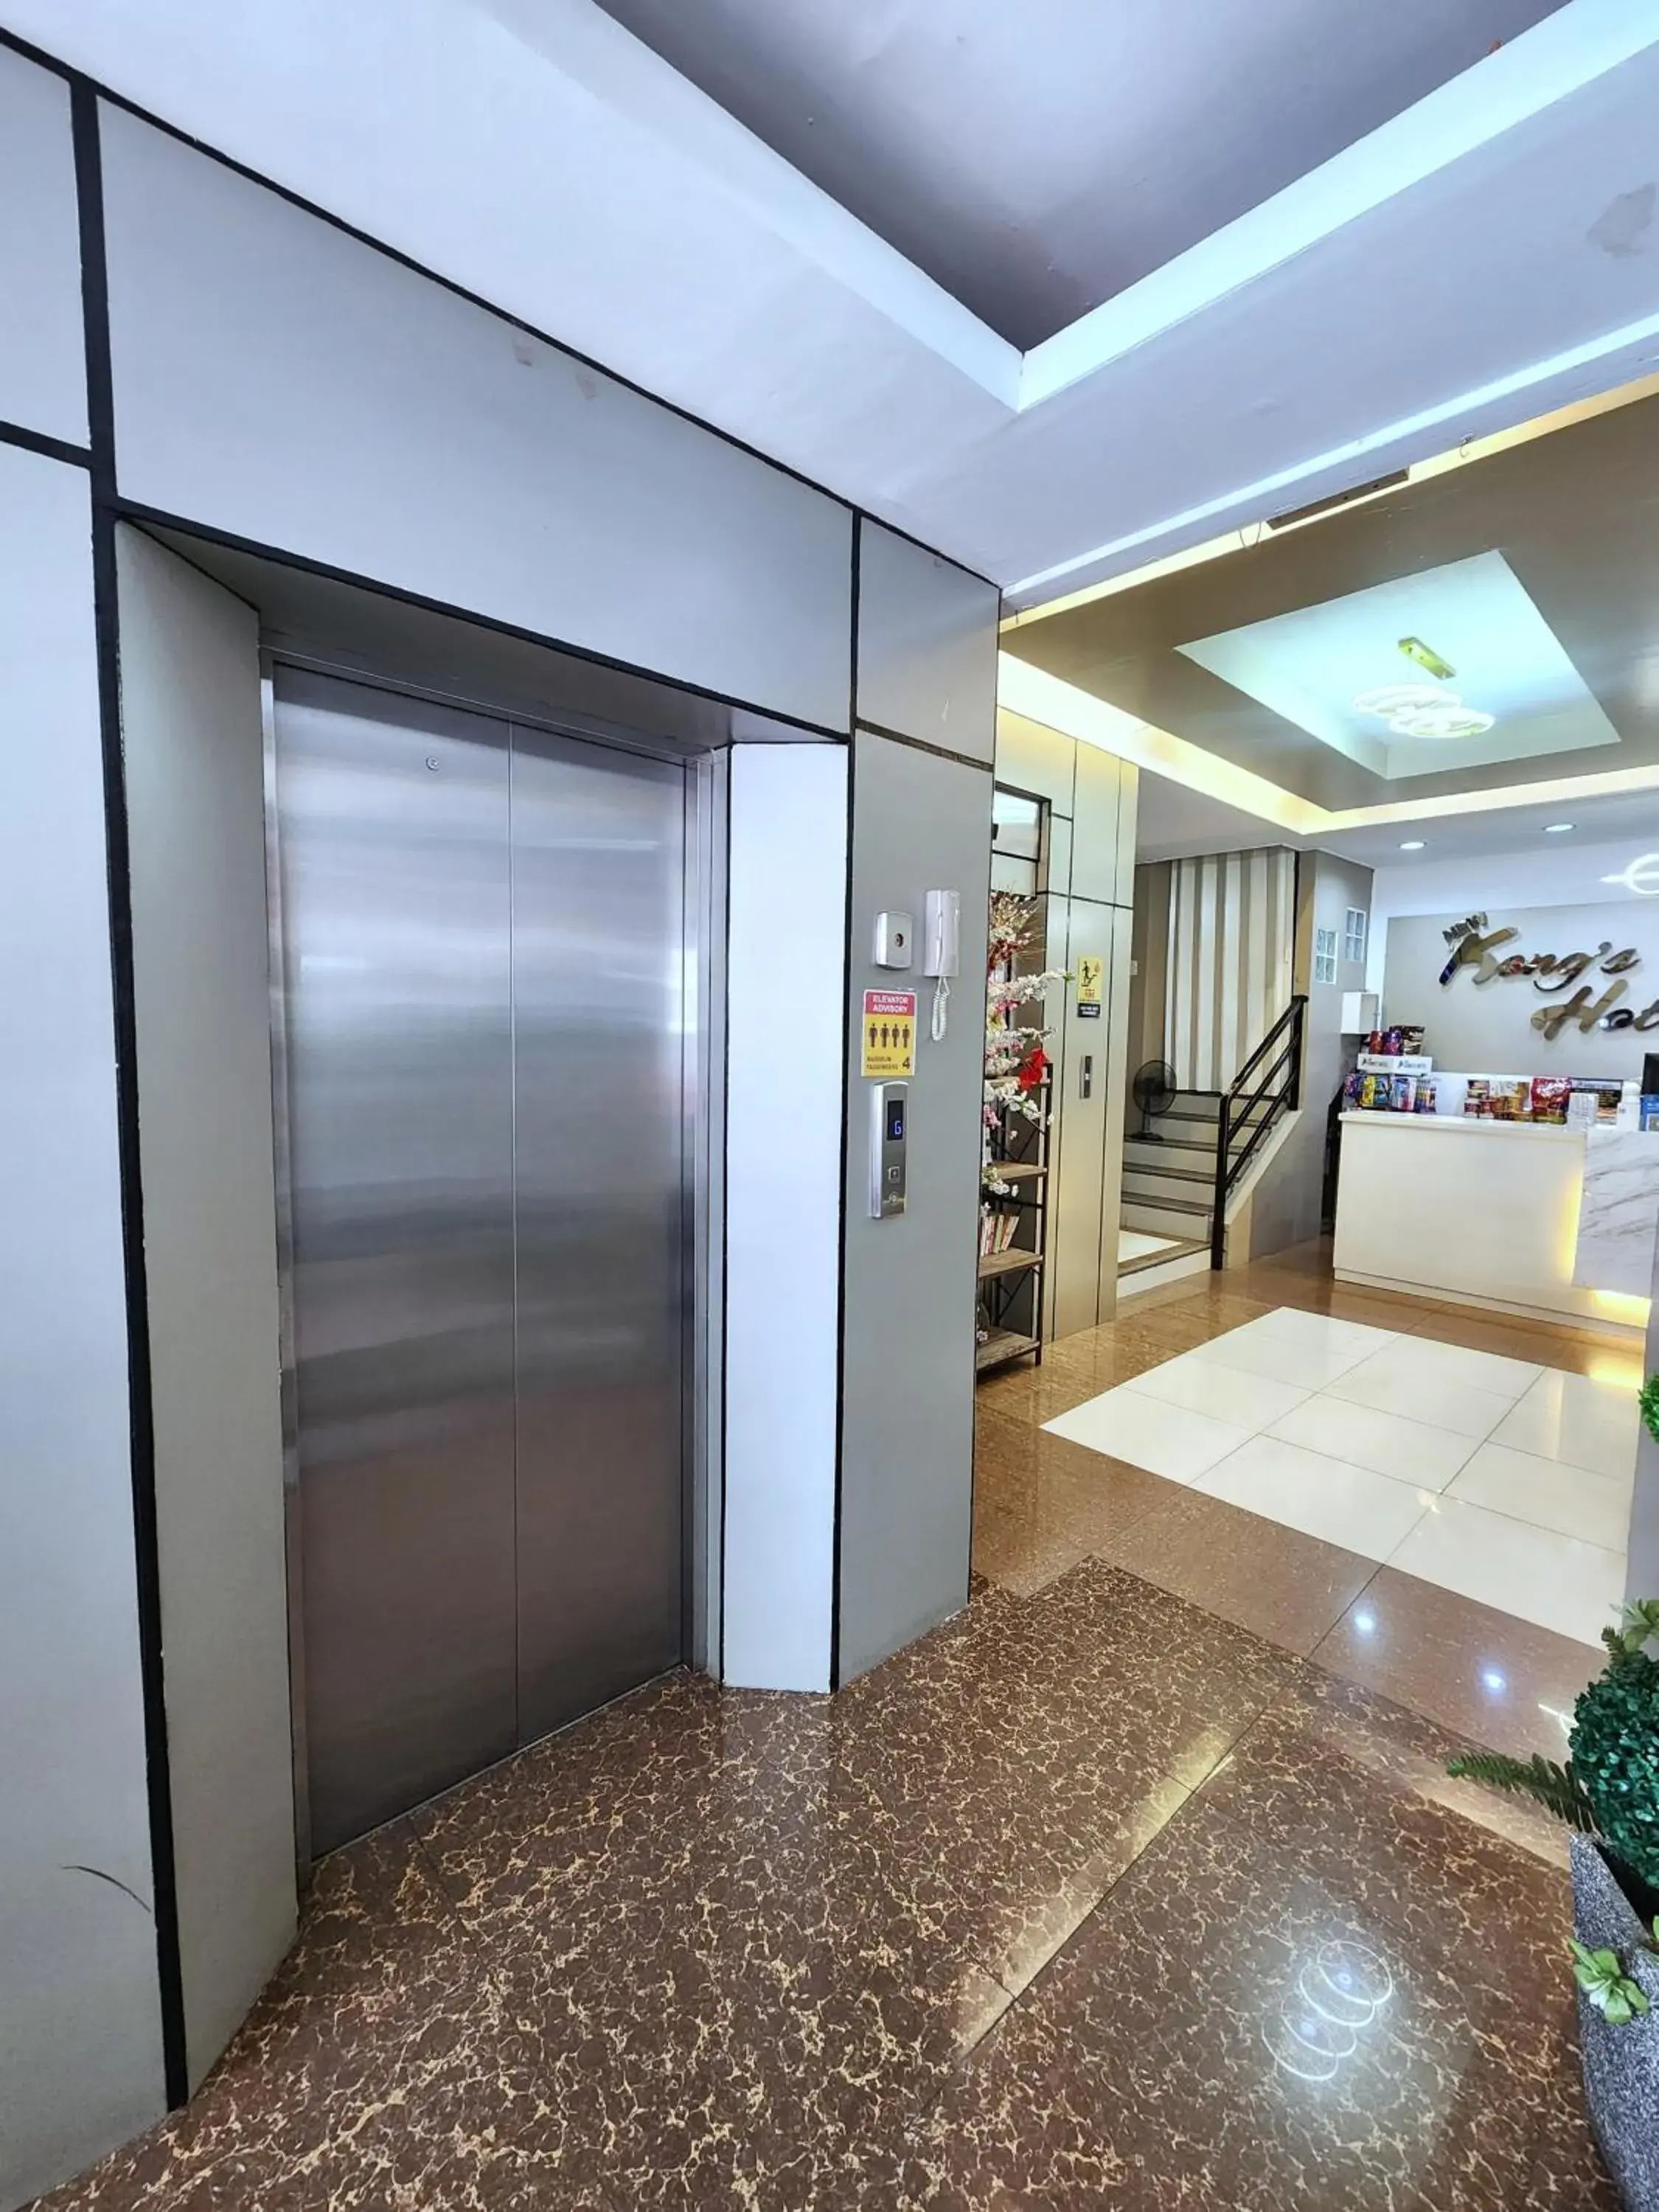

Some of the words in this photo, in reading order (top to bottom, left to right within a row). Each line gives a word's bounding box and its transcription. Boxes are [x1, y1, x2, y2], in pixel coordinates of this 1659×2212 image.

[872, 995, 908, 1004] ELEVATOR
[872, 1004, 908, 1014] ADVISORY
[902, 1056, 911, 1069] 4
